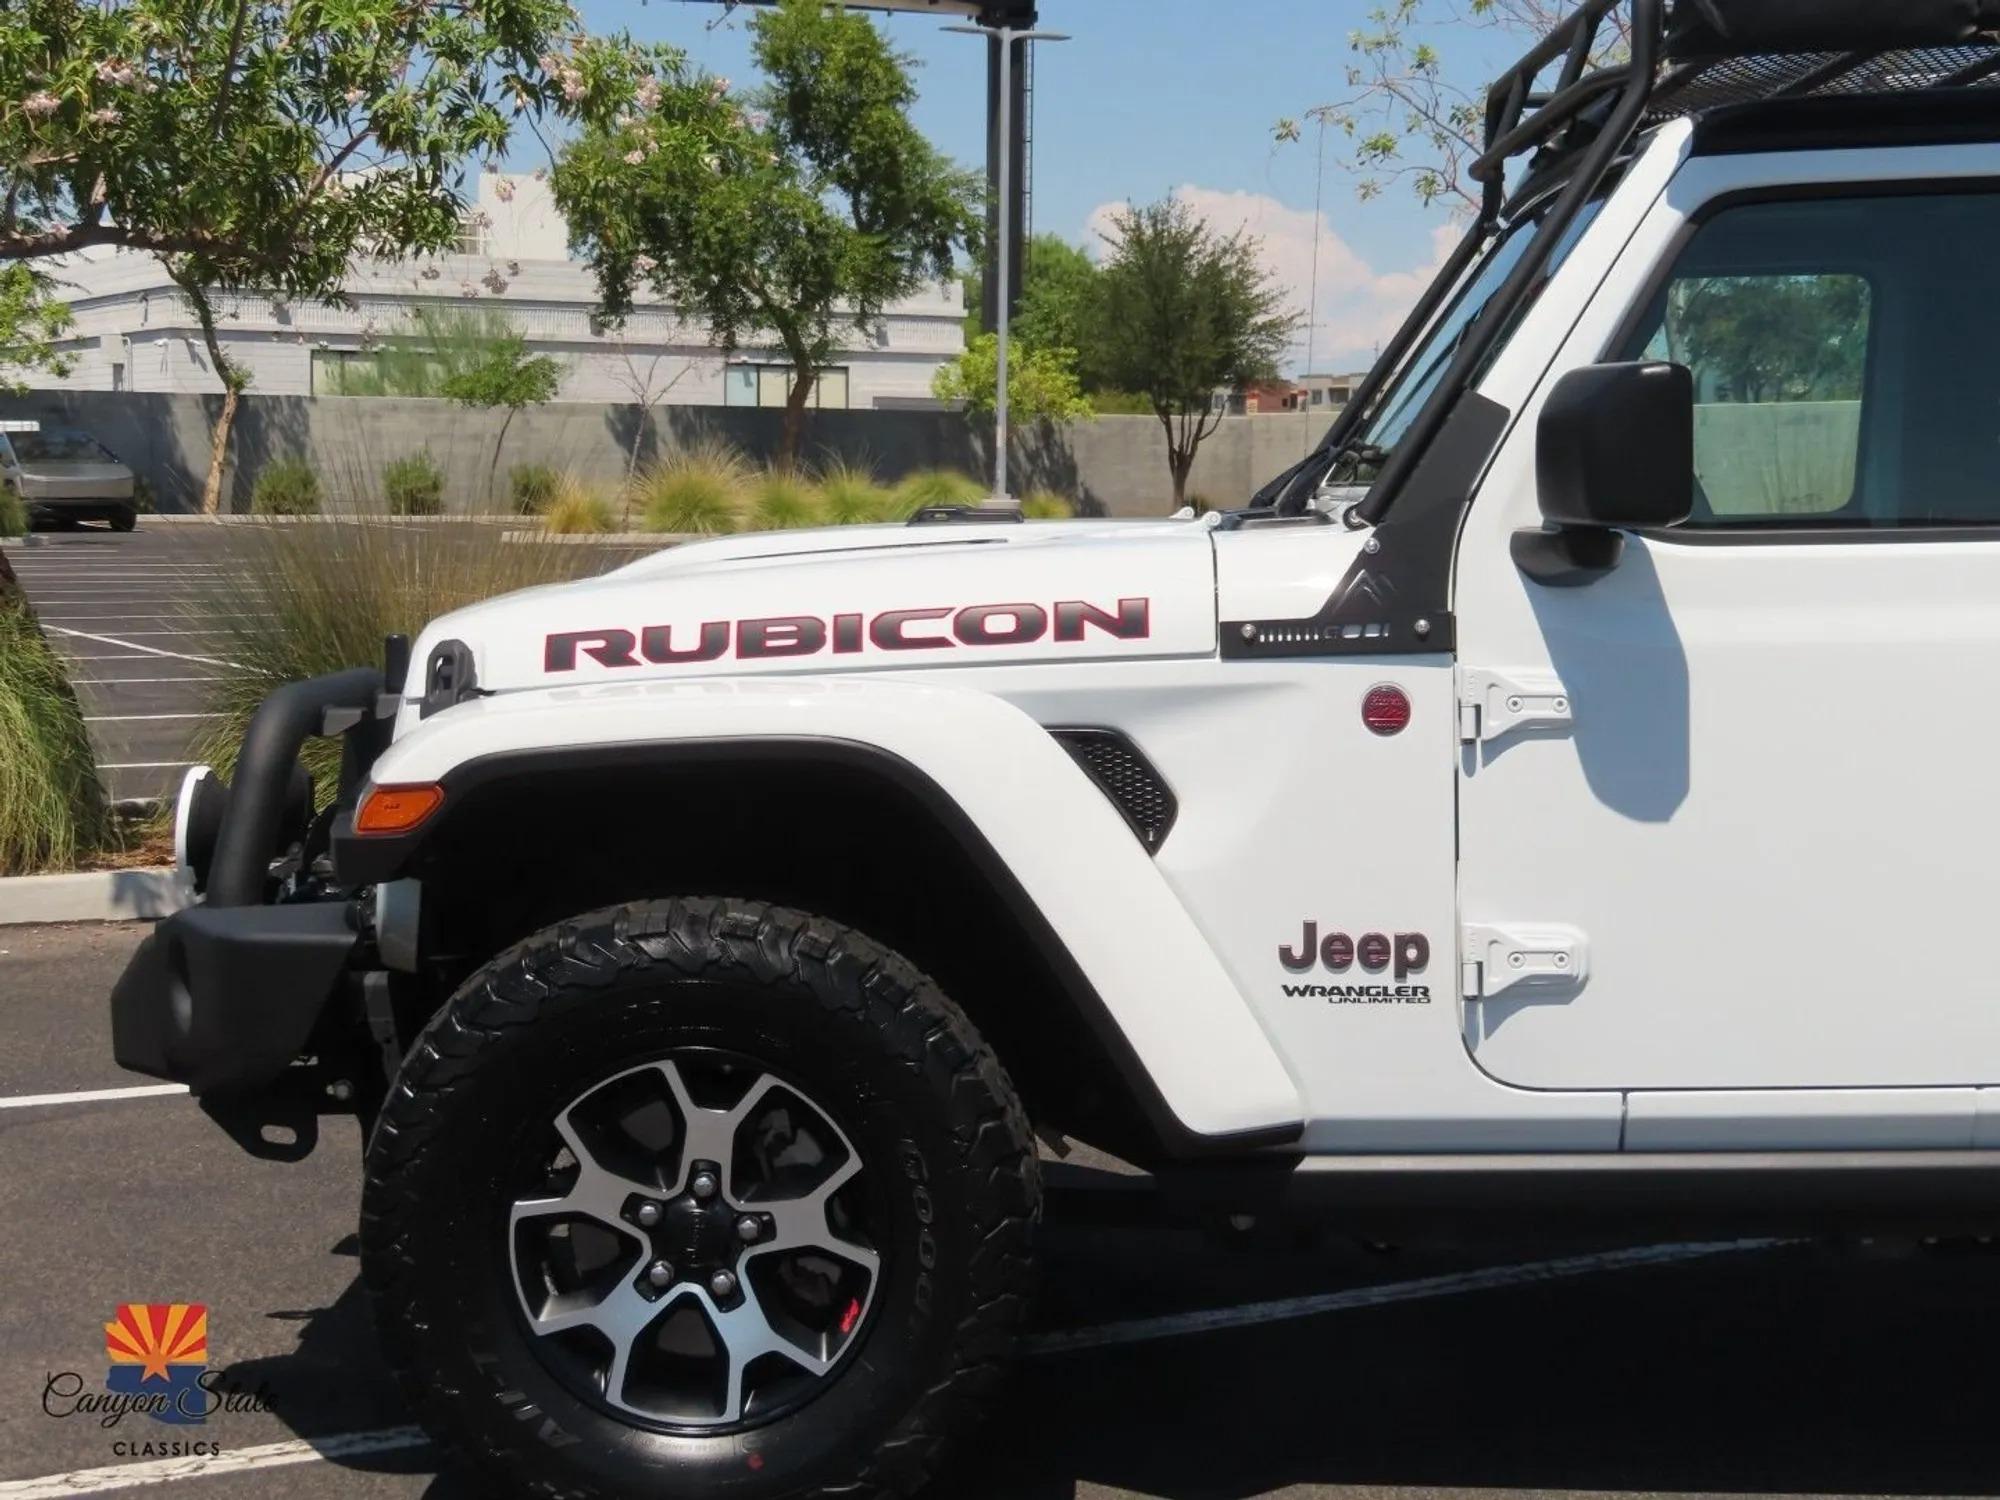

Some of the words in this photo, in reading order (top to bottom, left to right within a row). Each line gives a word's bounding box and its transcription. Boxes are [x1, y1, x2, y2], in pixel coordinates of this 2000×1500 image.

[544, 597, 1149, 673] RUBICON
[1278, 919, 1430, 983] Jeep
[1281, 984, 1430, 997] WRANGLER
